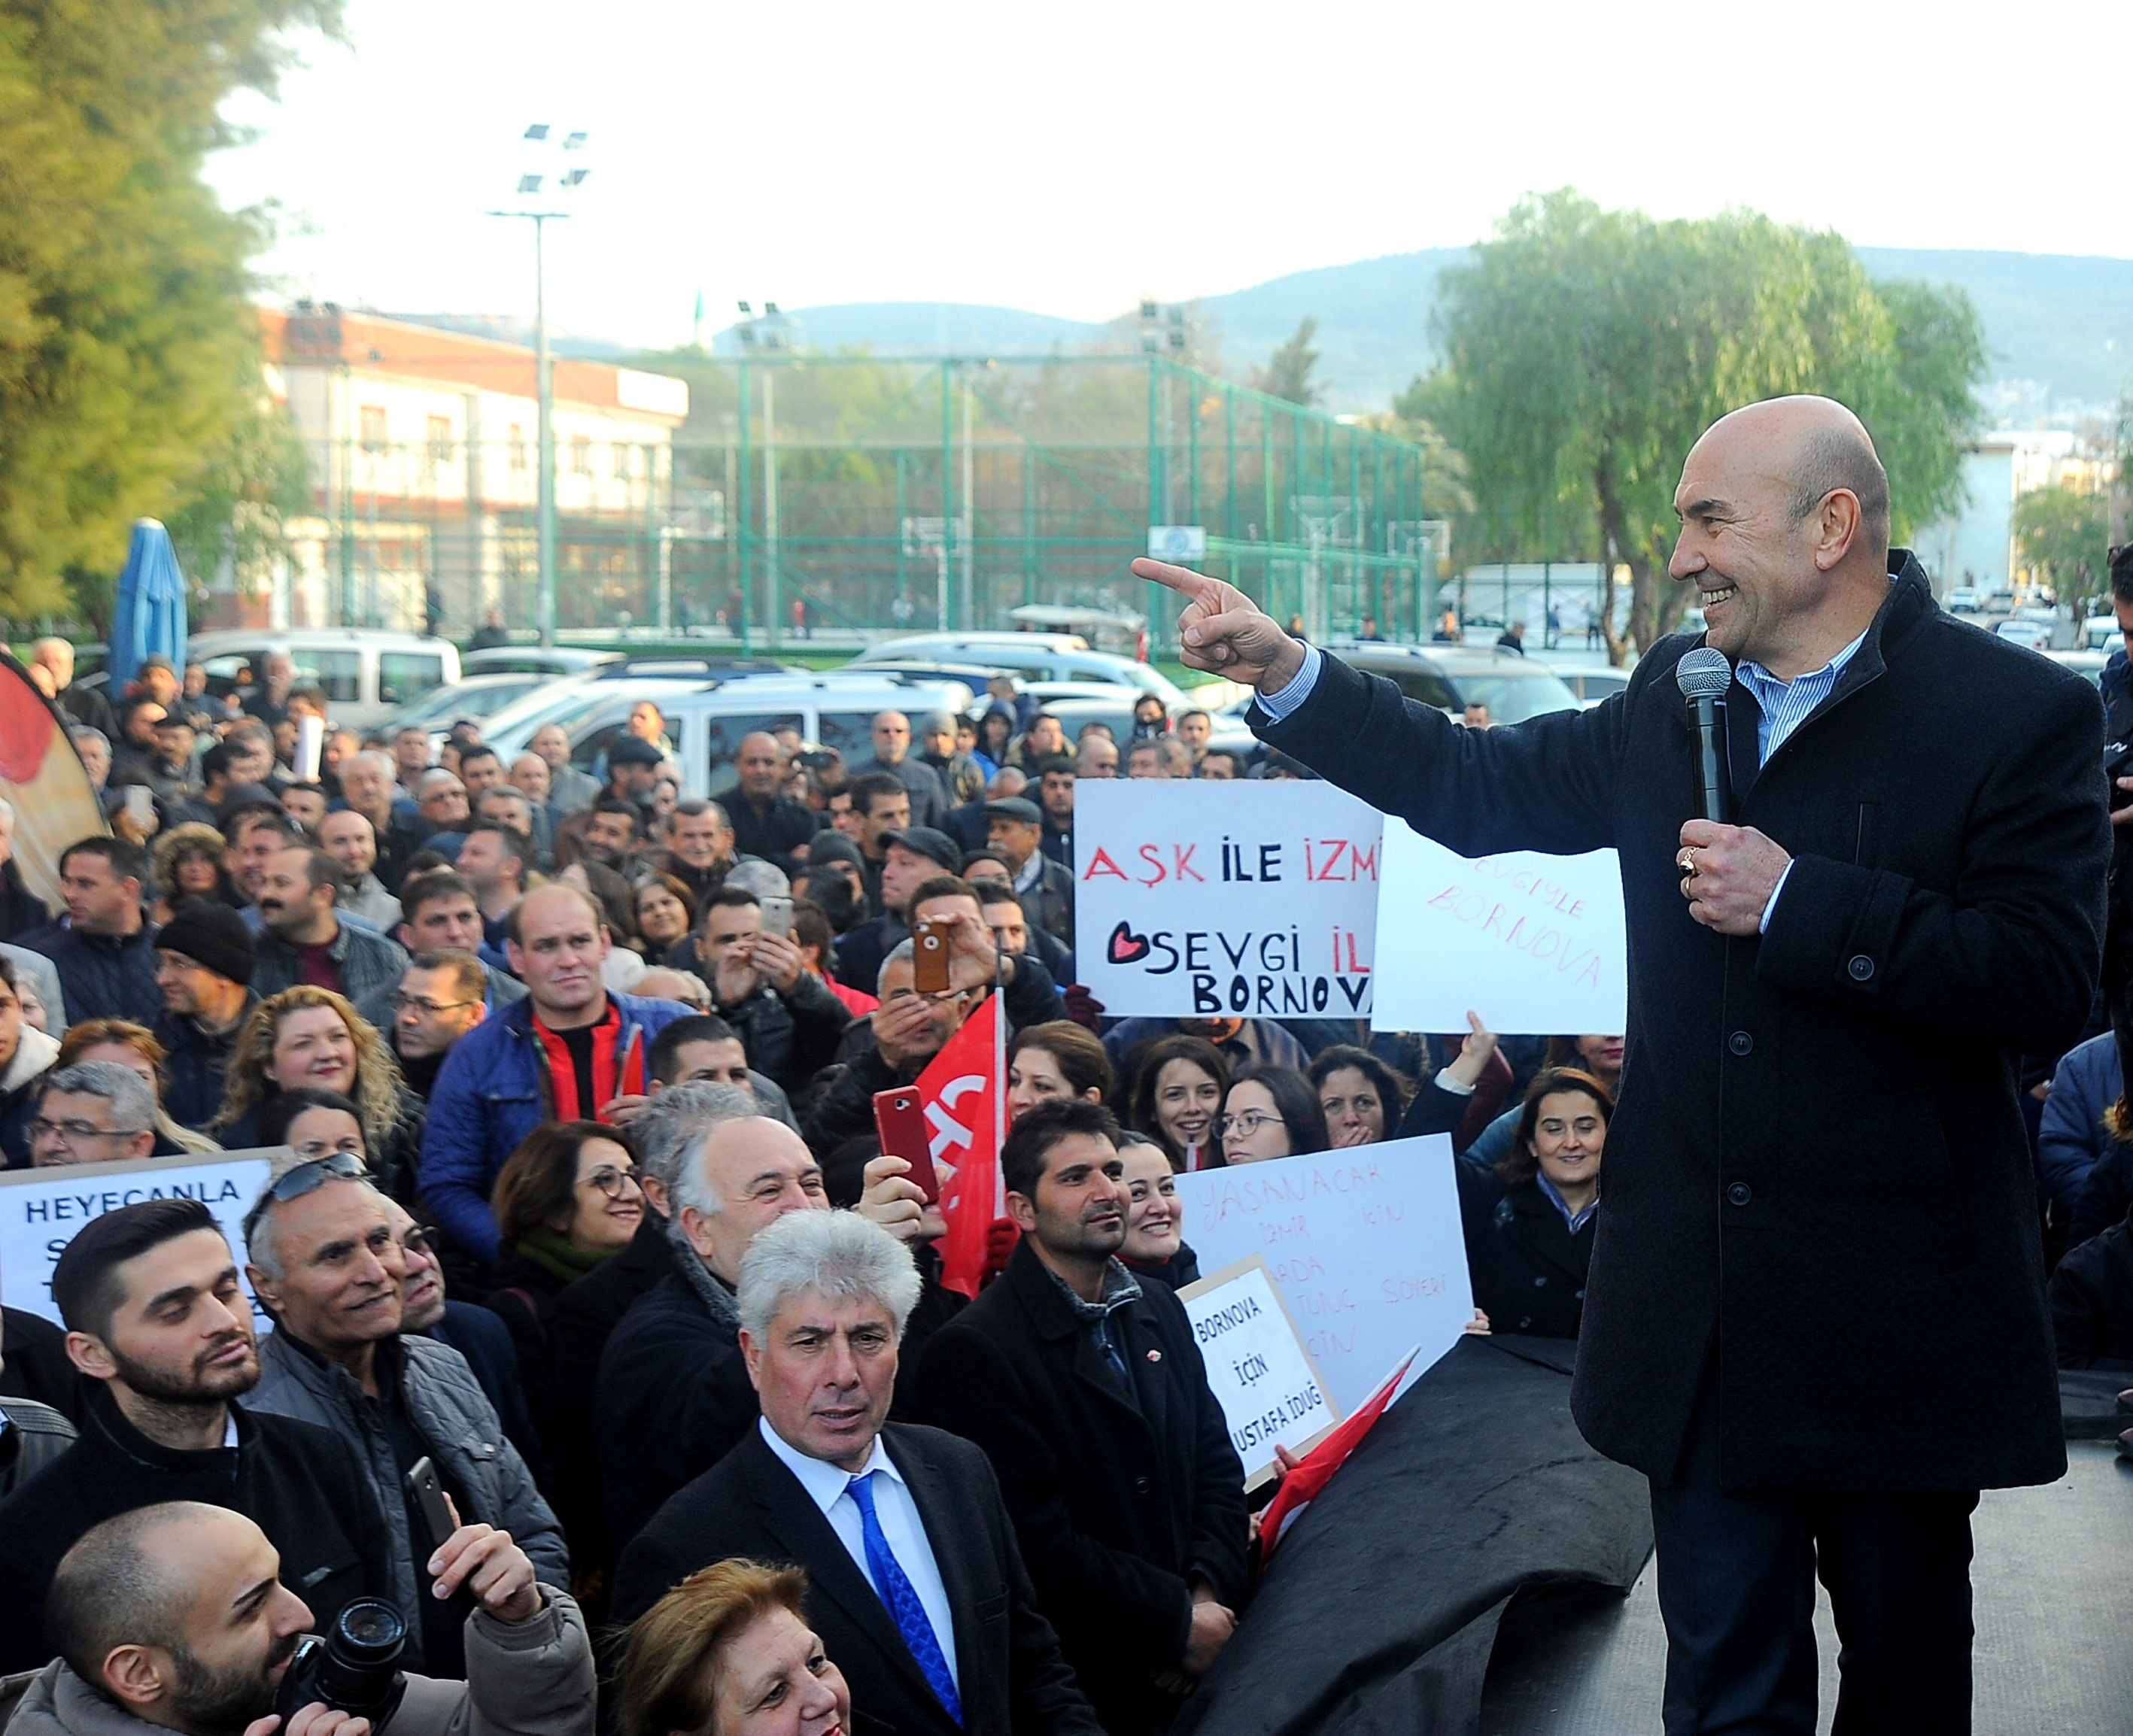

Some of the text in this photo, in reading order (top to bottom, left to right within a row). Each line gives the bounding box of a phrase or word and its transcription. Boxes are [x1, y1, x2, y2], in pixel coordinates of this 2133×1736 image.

[1083, 840, 1205, 888] AŞK
[1221, 836, 1282, 882] İLE
[1144, 924, 1372, 974] SEVGİ İL
[1427, 885, 1600, 988] BORNOVA
[1193, 976, 1373, 1014] BORNOV
[1195, 1296, 1262, 1343] BORNOVA
[1232, 1352, 1269, 1387] İÇİN
[1233, 1406, 1290, 1452] USTAFA
